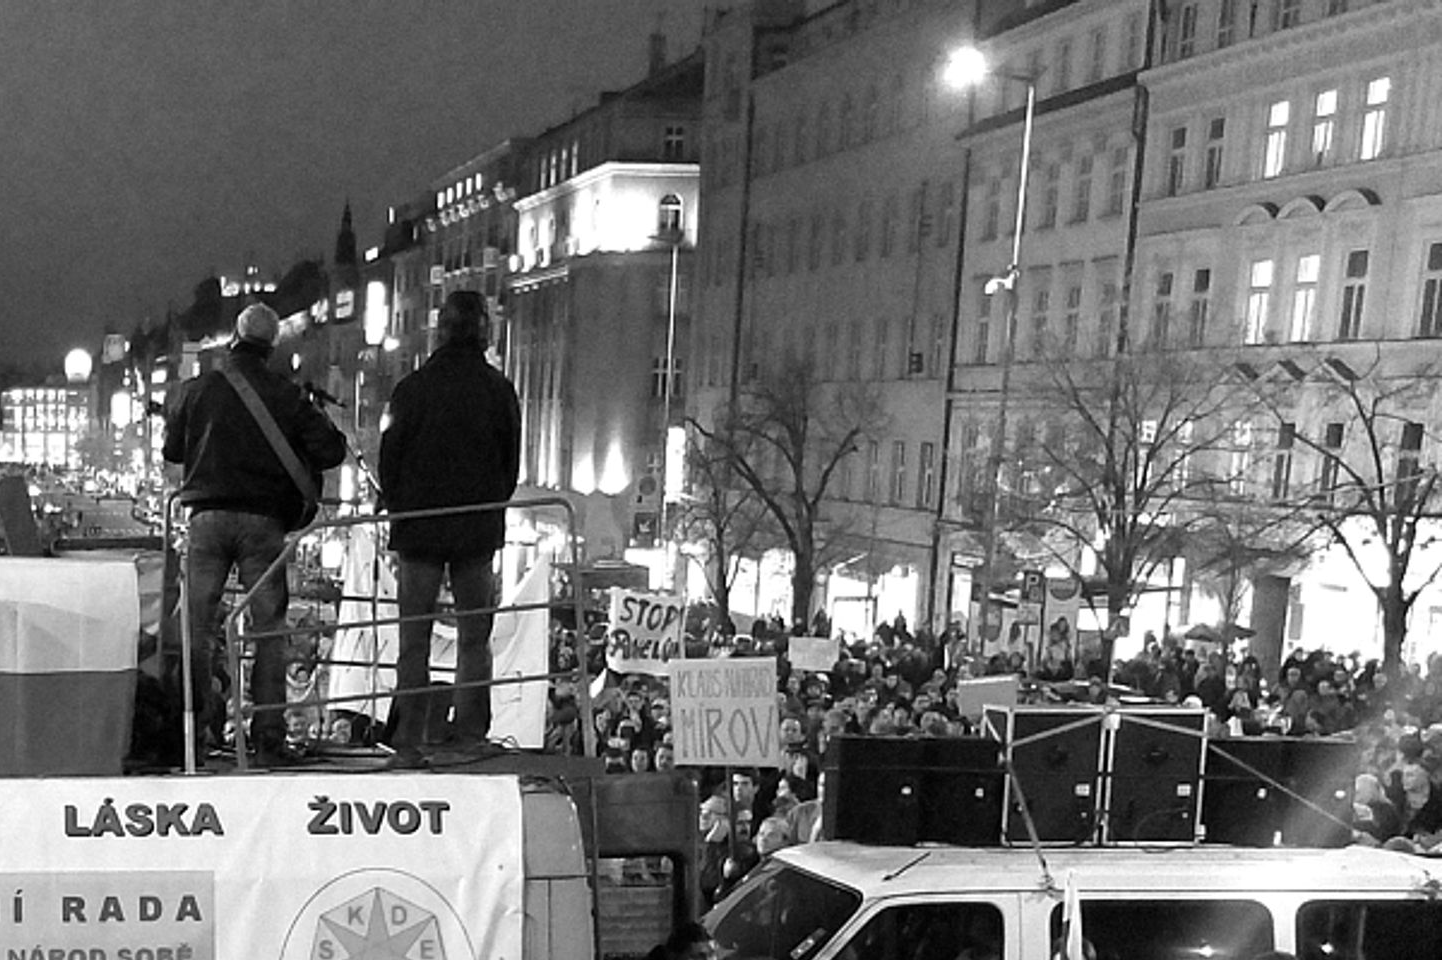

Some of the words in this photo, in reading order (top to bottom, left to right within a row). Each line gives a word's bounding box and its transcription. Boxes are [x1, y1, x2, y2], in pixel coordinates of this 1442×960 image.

[64, 797, 225, 837] LÁSKA
[307, 795, 451, 835] ŽIVOT
[62, 895, 203, 923] RADA
